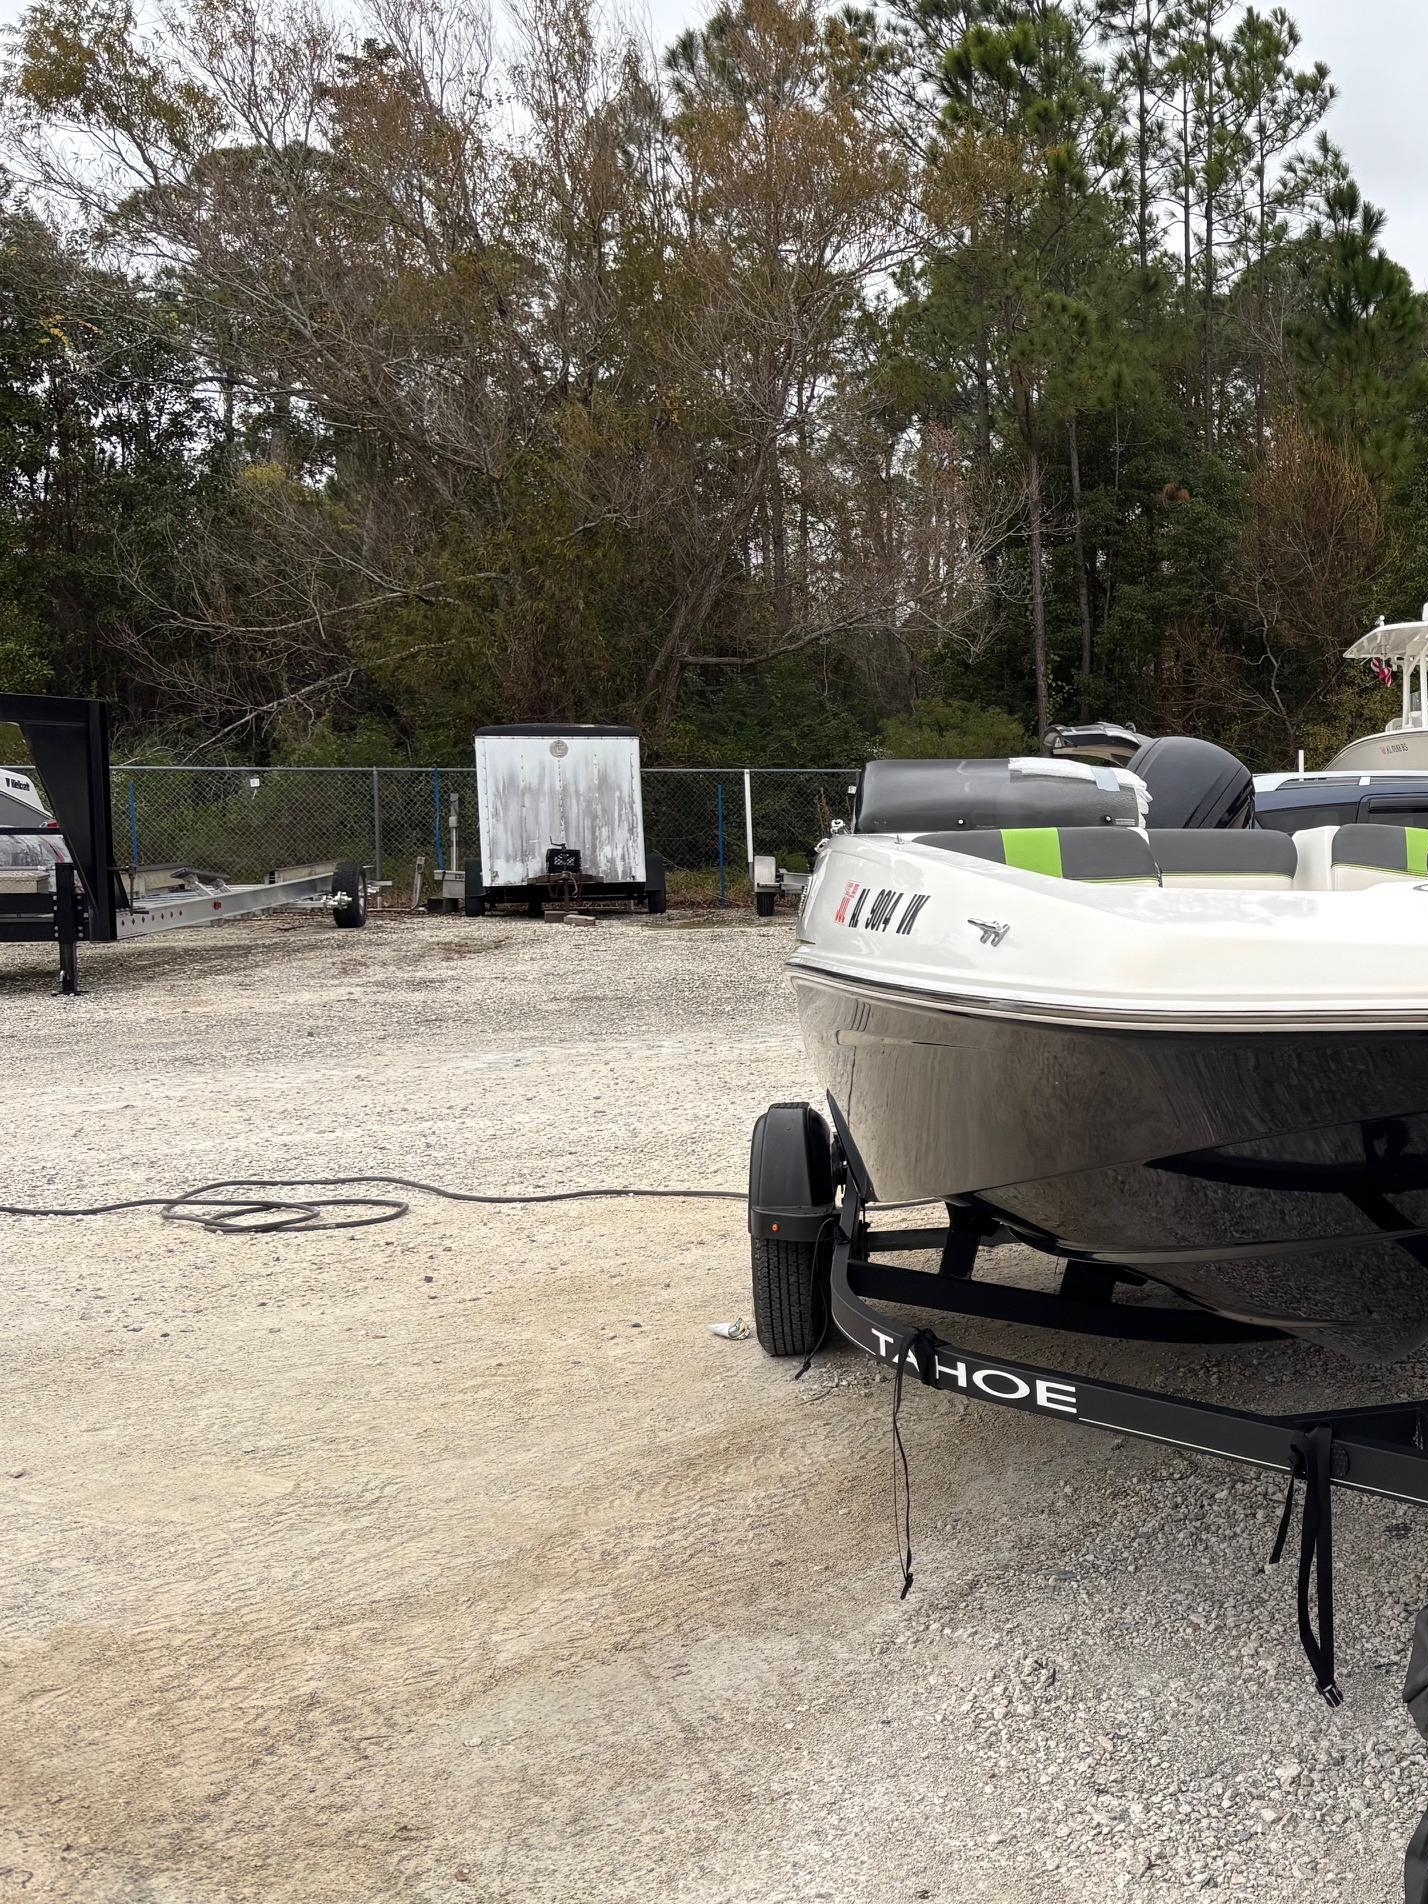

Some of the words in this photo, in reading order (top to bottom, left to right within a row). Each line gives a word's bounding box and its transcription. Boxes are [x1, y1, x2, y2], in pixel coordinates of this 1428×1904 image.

[848, 888, 870, 928] AL
[864, 888, 904, 932] 9014
[895, 893, 931, 935] VK
